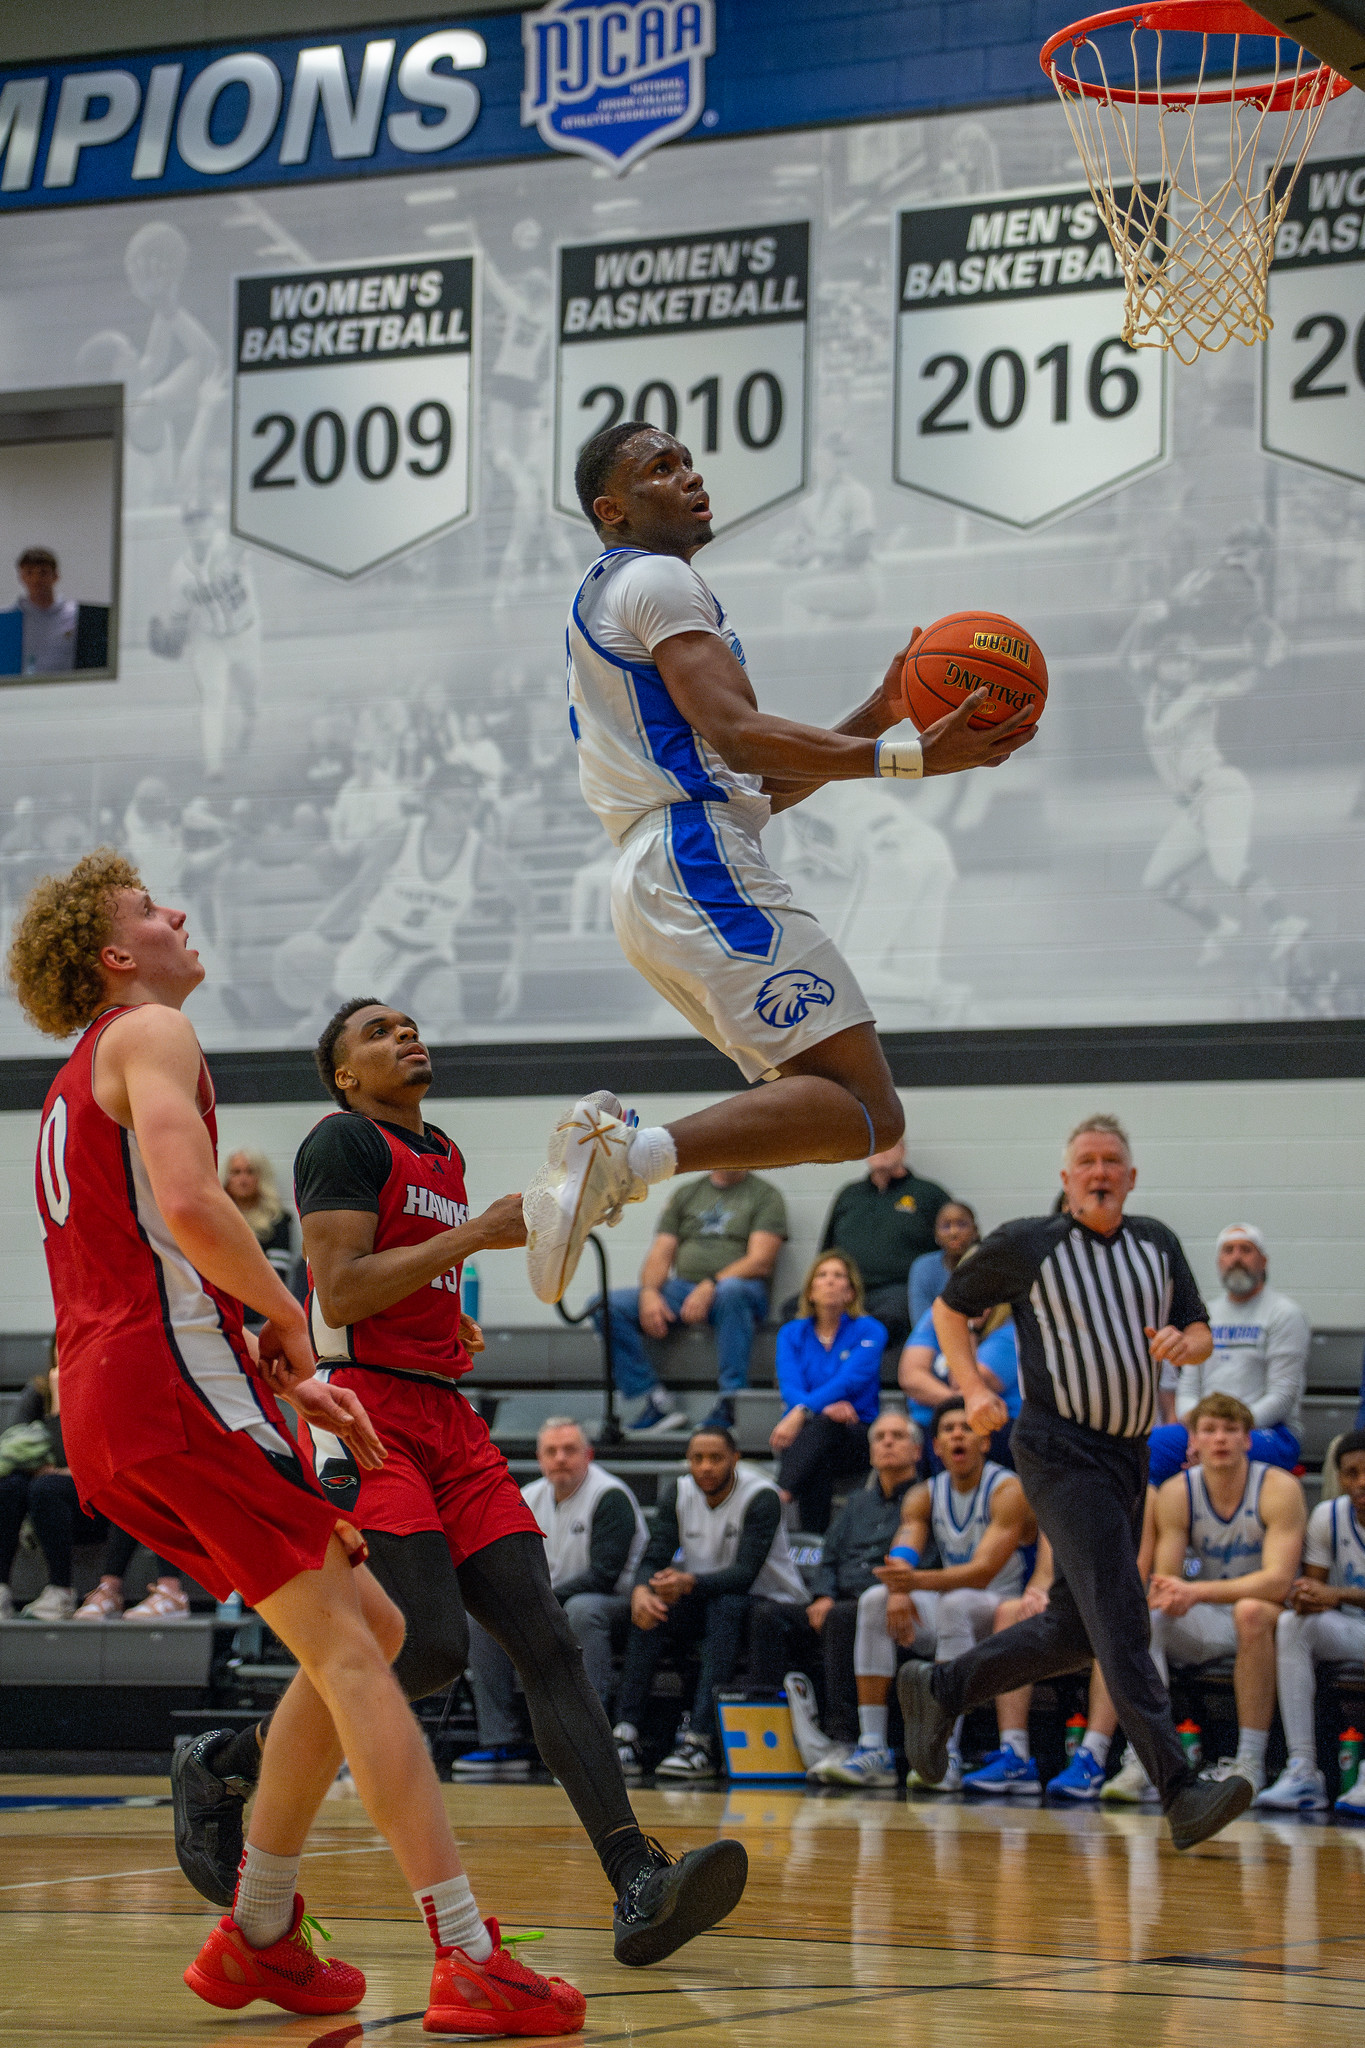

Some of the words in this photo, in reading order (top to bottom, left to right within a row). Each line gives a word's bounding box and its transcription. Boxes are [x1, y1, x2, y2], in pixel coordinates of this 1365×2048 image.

[532, 3, 702, 107] NJCAA
[966, 201, 1099, 251] MEN'S
[1275, 211, 1365, 260] BAS
[594, 237, 778, 290] WOMEN'S
[269, 270, 444, 321] WOMEN'S
[563, 275, 805, 334] BASKETBALL
[240, 308, 469, 363] BASKETBALL
[1292, 311, 1365, 401] 2
[919, 336, 1139, 436] 2016
[252, 400, 452, 489] 2009
[974, 632, 1031, 669] NJCAA
[36, 1093, 71, 1241] 0
[402, 1184, 469, 1228] HAWK
